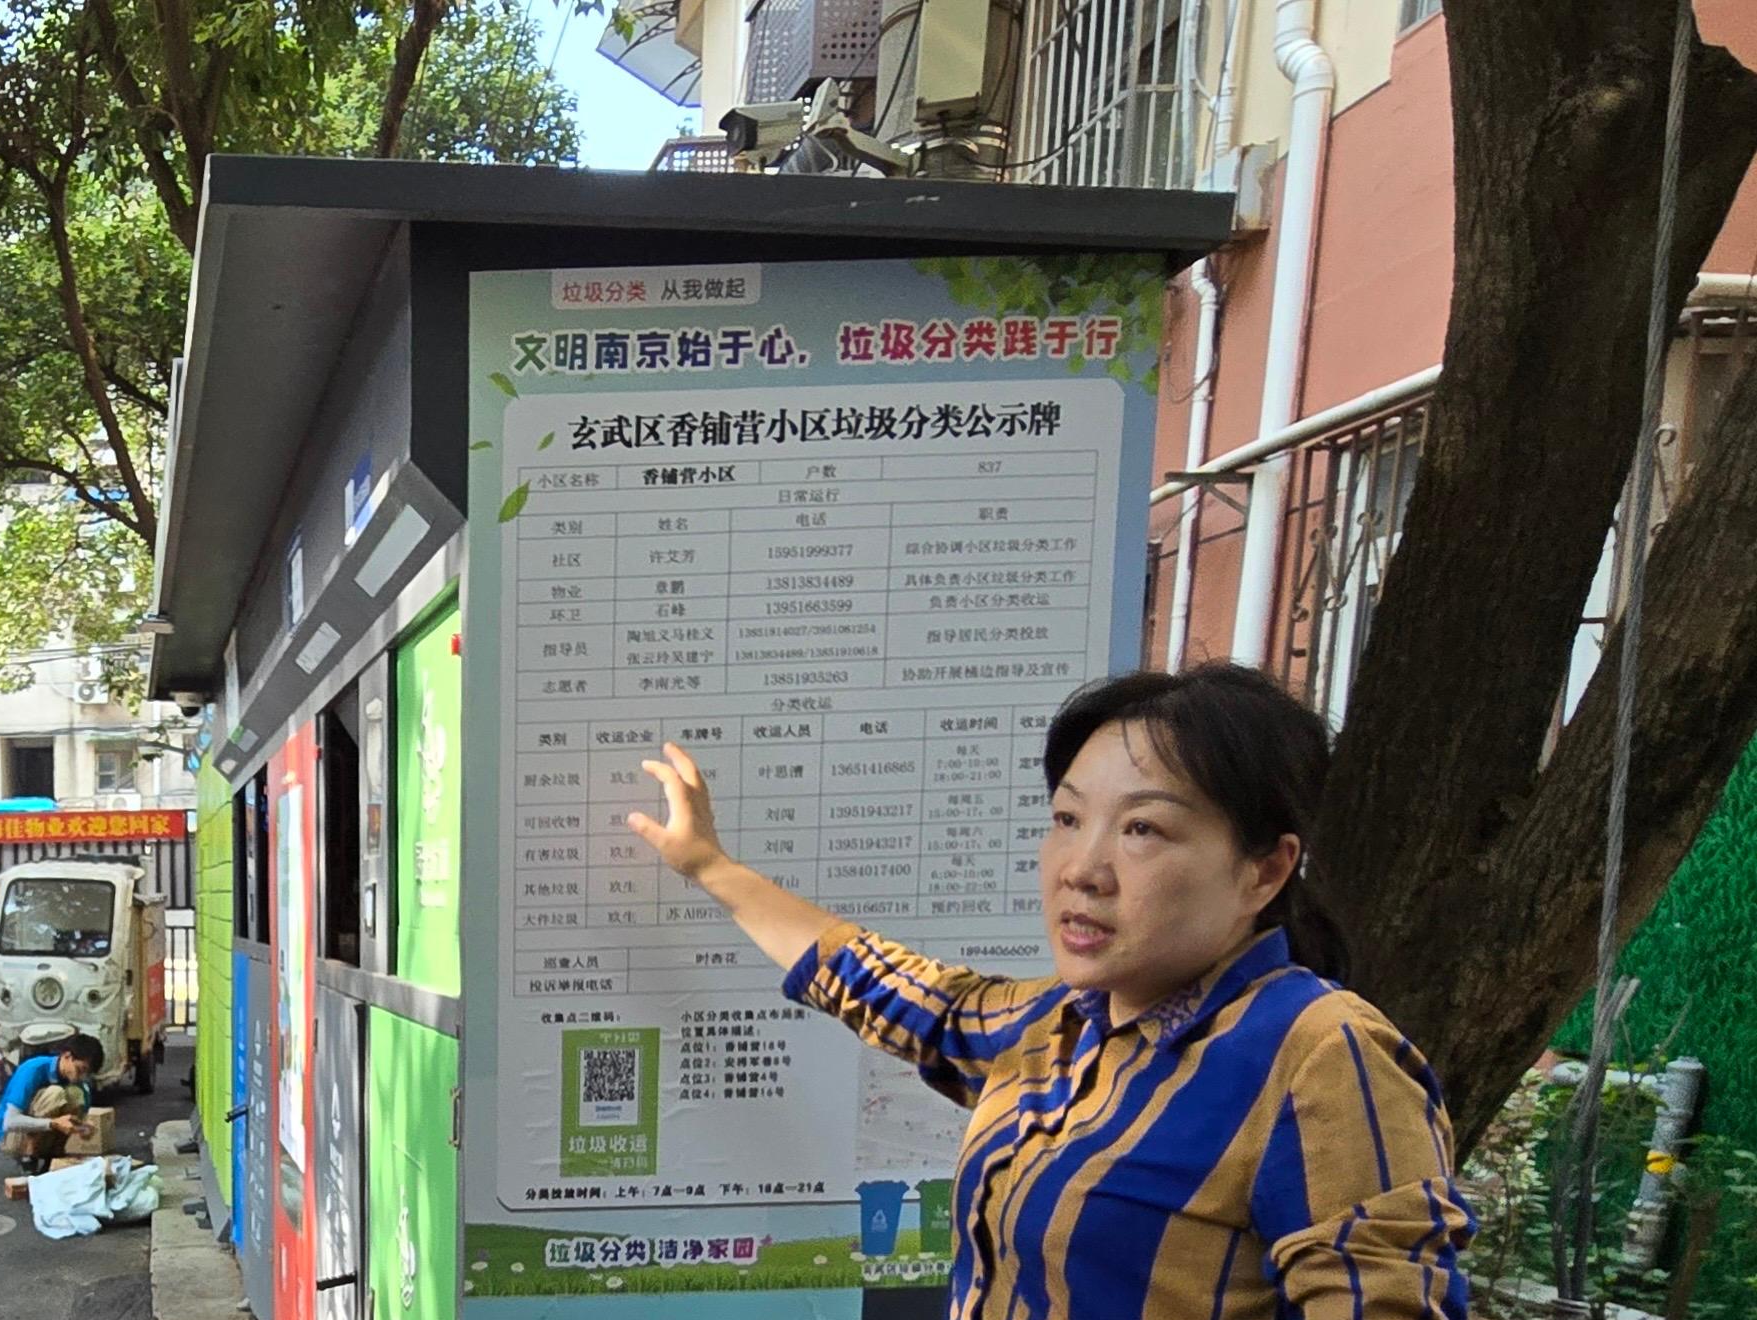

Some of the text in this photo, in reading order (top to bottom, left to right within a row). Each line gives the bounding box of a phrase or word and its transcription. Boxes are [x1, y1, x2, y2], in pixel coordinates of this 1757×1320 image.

[562, 277, 745, 303] 垃圾分类 从我做起
[567, 401, 1062, 450] 玄武区香铺营小区垃圾分类公示牌
[537, 460, 1003, 489] 小区名称 香铺营小区 户数 837
[778, 487, 840, 504] 日常运行
[551, 520, 583, 535] 类别
[658, 516, 689, 531] 姓名
[795, 512, 827, 527] 电话
[552, 553, 581, 568] 社区
[905, 537, 1077, 555] 综合协调小区垃圾分类工作
[552, 585, 583, 599] 物业
[550, 608, 582, 622] 环卫
[543, 642, 588, 658] 指导员
[543, 679, 588, 694] 志愿者
[771, 696, 833, 711] 分类收运
[538, 733, 567, 747] 类别
[596, 731, 654, 744] 收运企业
[681, 727, 723, 740] 车牌号
[753, 724, 812, 739] 收运人员
[859, 721, 889, 736] 电话
[940, 716, 999, 732] 收运时间
[523, 910, 578, 925] 大件垃圾
[529, 977, 613, 992] 投诉举报电话
[569, 1135, 648, 1154] 垃圾收运
[549, 1237, 755, 1263] 垃圾分类 洁净家园
